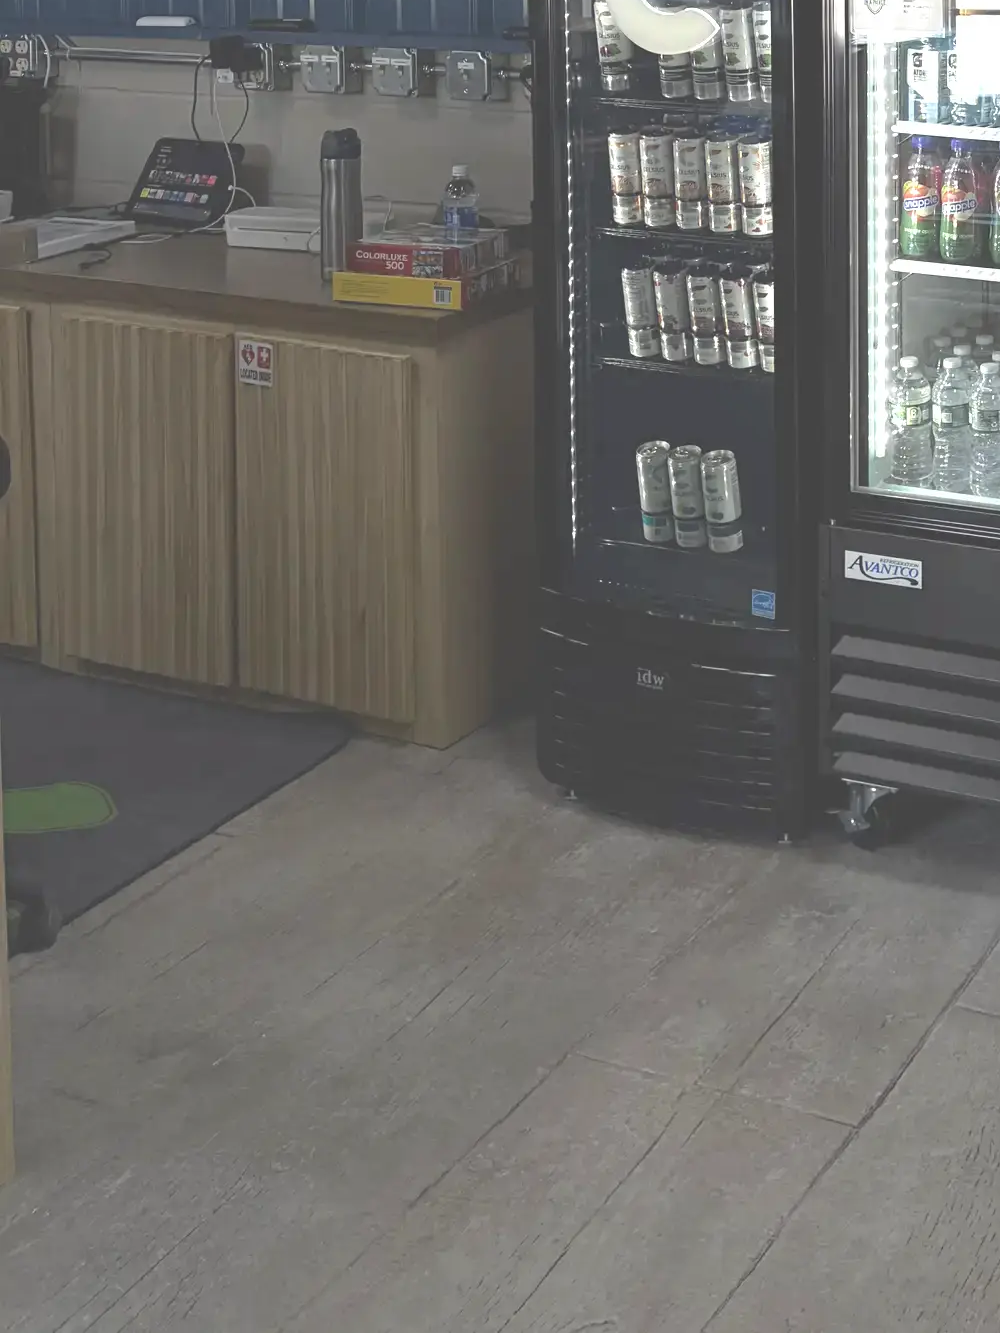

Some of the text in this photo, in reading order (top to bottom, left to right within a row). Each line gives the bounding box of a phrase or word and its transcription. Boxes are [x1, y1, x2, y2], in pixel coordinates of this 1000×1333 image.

[904, 195, 938, 210] snapple
[356, 250, 408, 262] COLORLUXE
[385, 261, 404, 271] 500
[847, 554, 919, 583] AVANTCO
